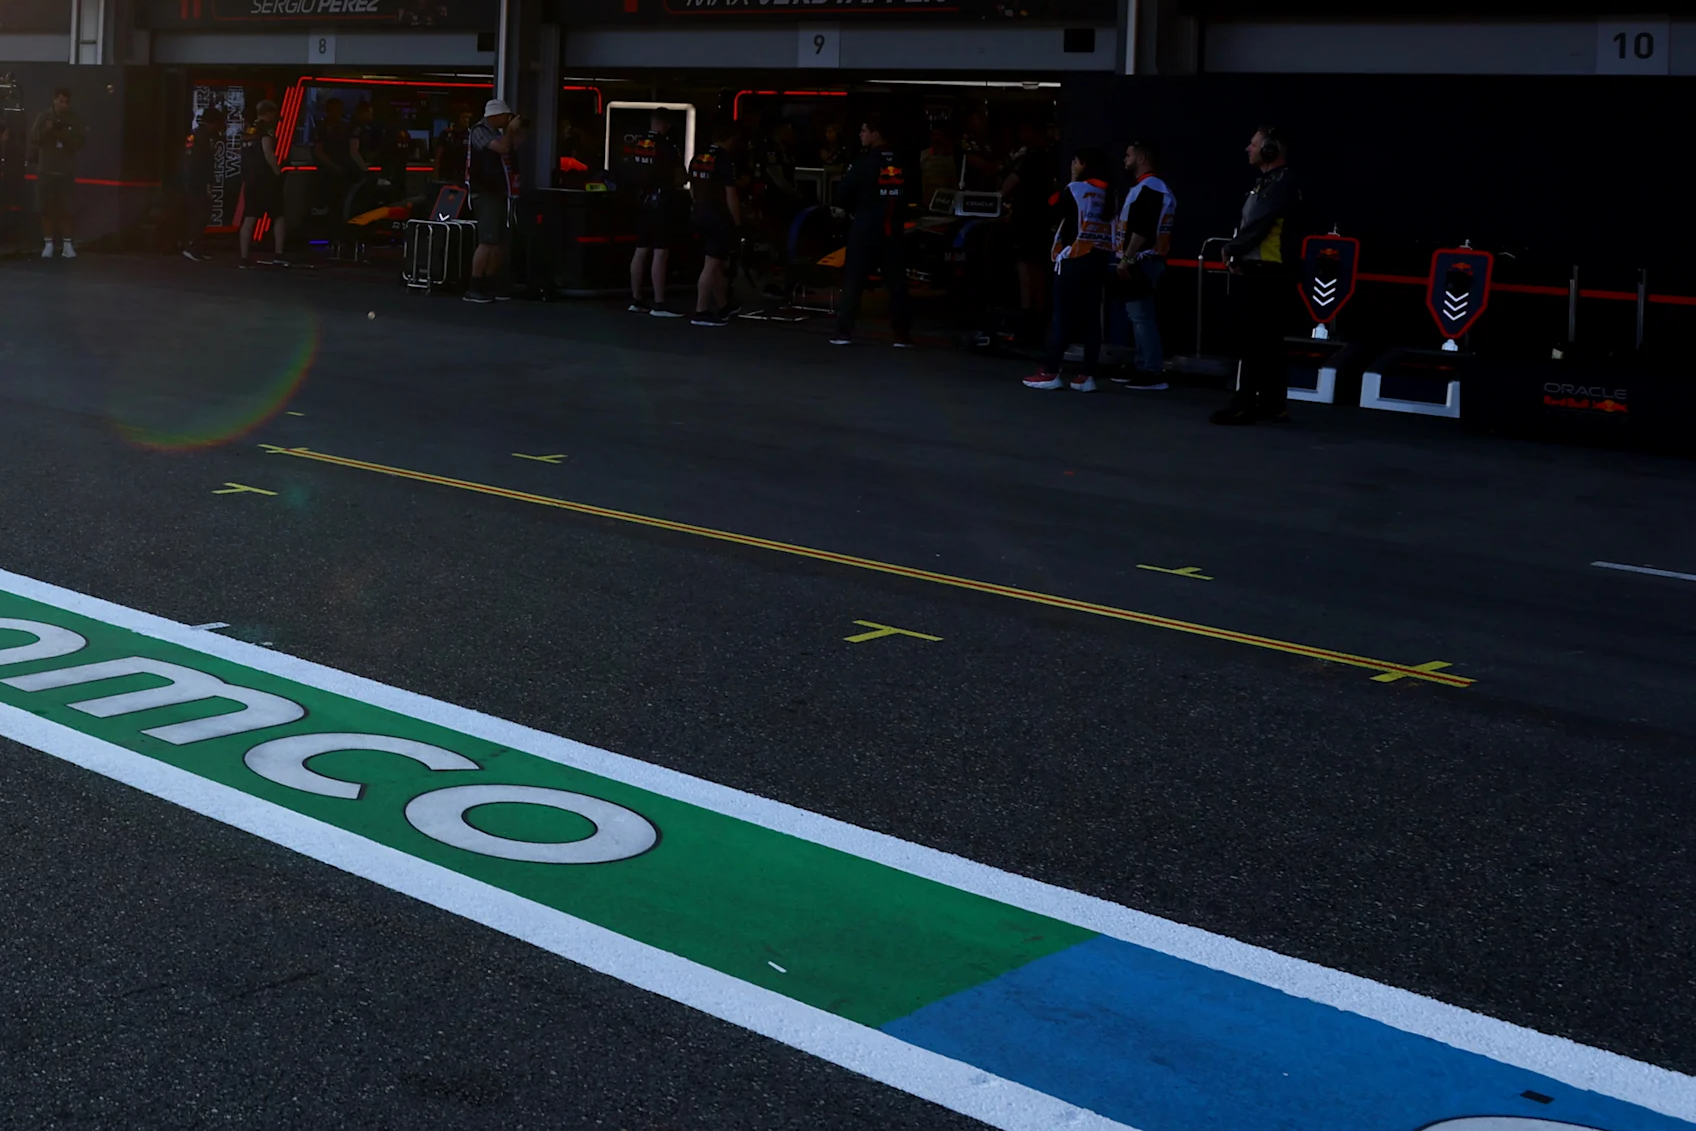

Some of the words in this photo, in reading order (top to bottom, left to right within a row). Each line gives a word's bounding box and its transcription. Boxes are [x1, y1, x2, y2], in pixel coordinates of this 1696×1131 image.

[318, 38, 327, 54] 8
[813, 35, 825, 55] 9
[1613, 32, 1654, 59] 10
[1543, 382, 1628, 400] ORACLE
